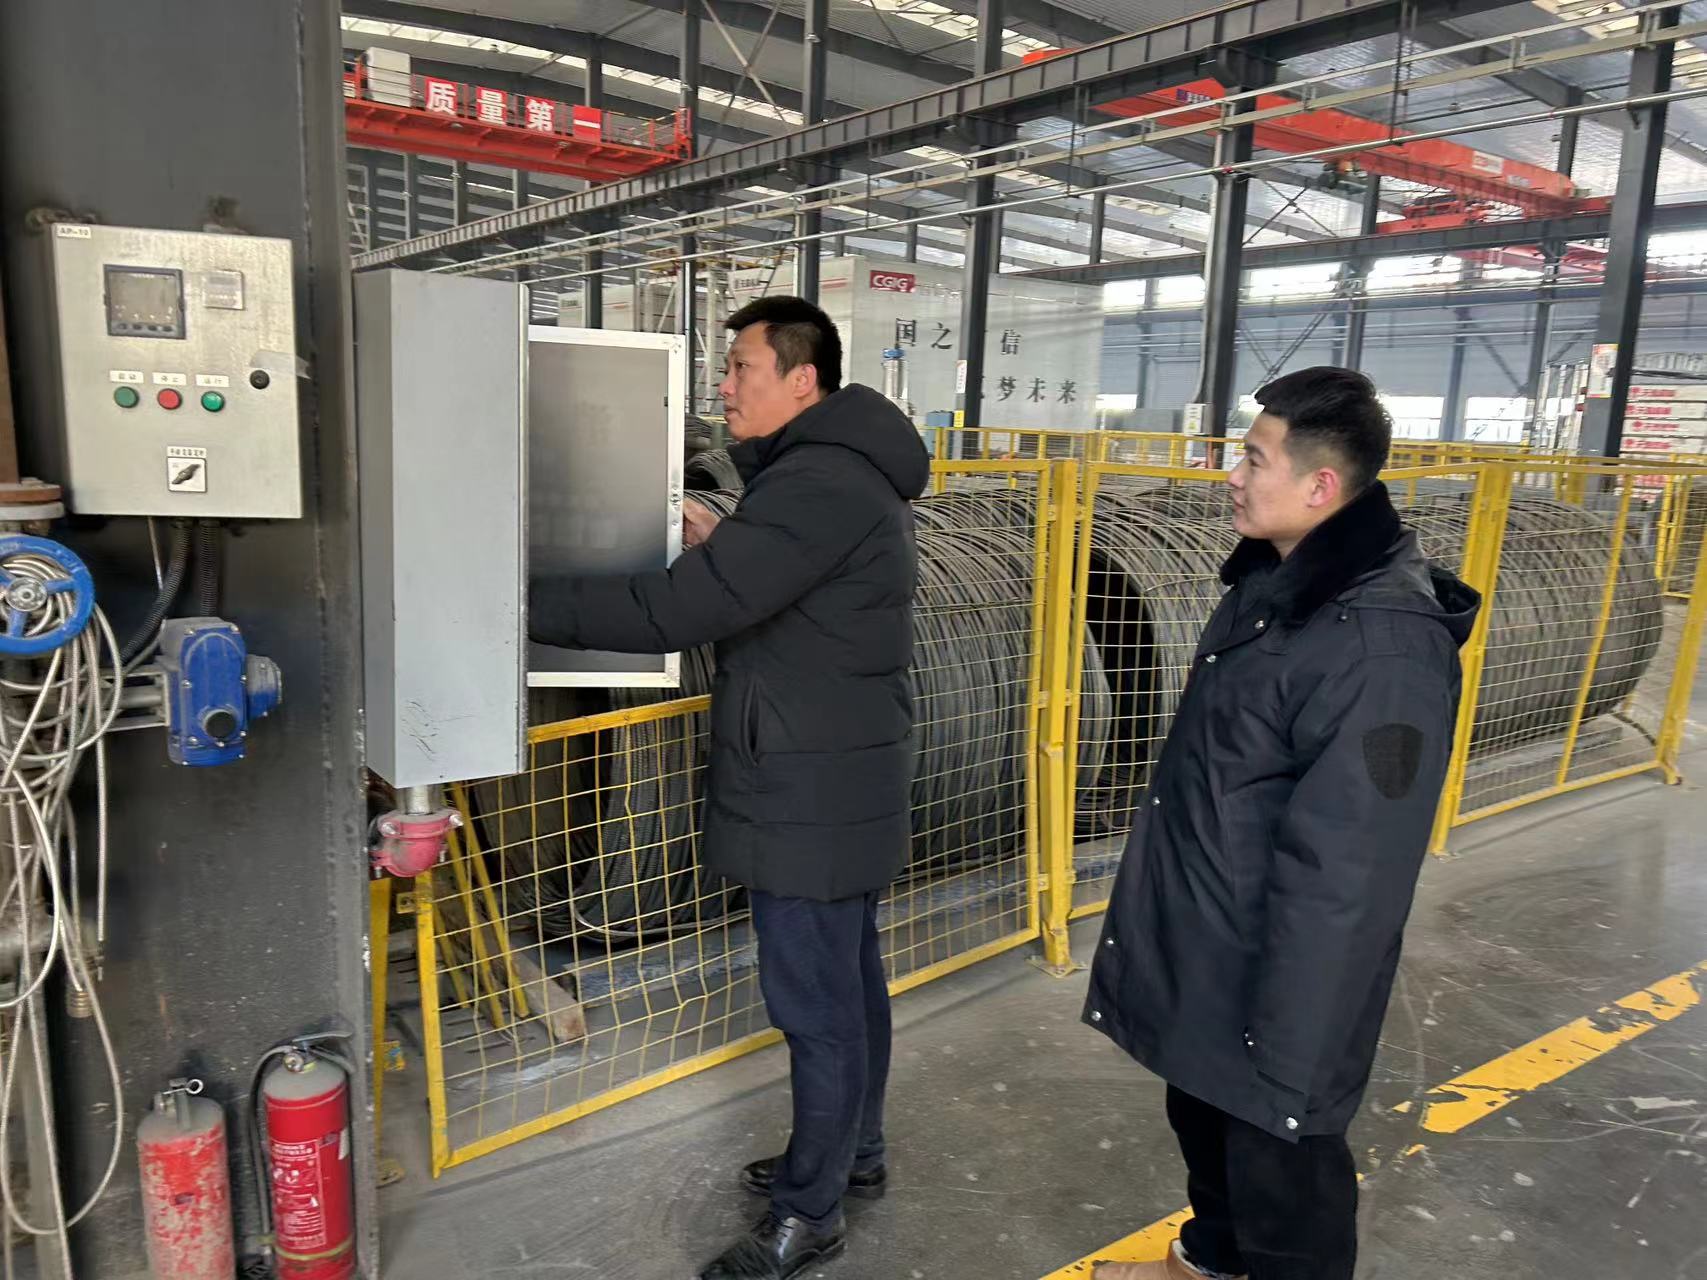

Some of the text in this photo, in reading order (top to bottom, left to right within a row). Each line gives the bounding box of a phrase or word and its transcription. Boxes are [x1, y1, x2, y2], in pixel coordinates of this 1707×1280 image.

[427, 80, 600, 132] 质量第一
[895, 318, 1022, 356] 国之信
